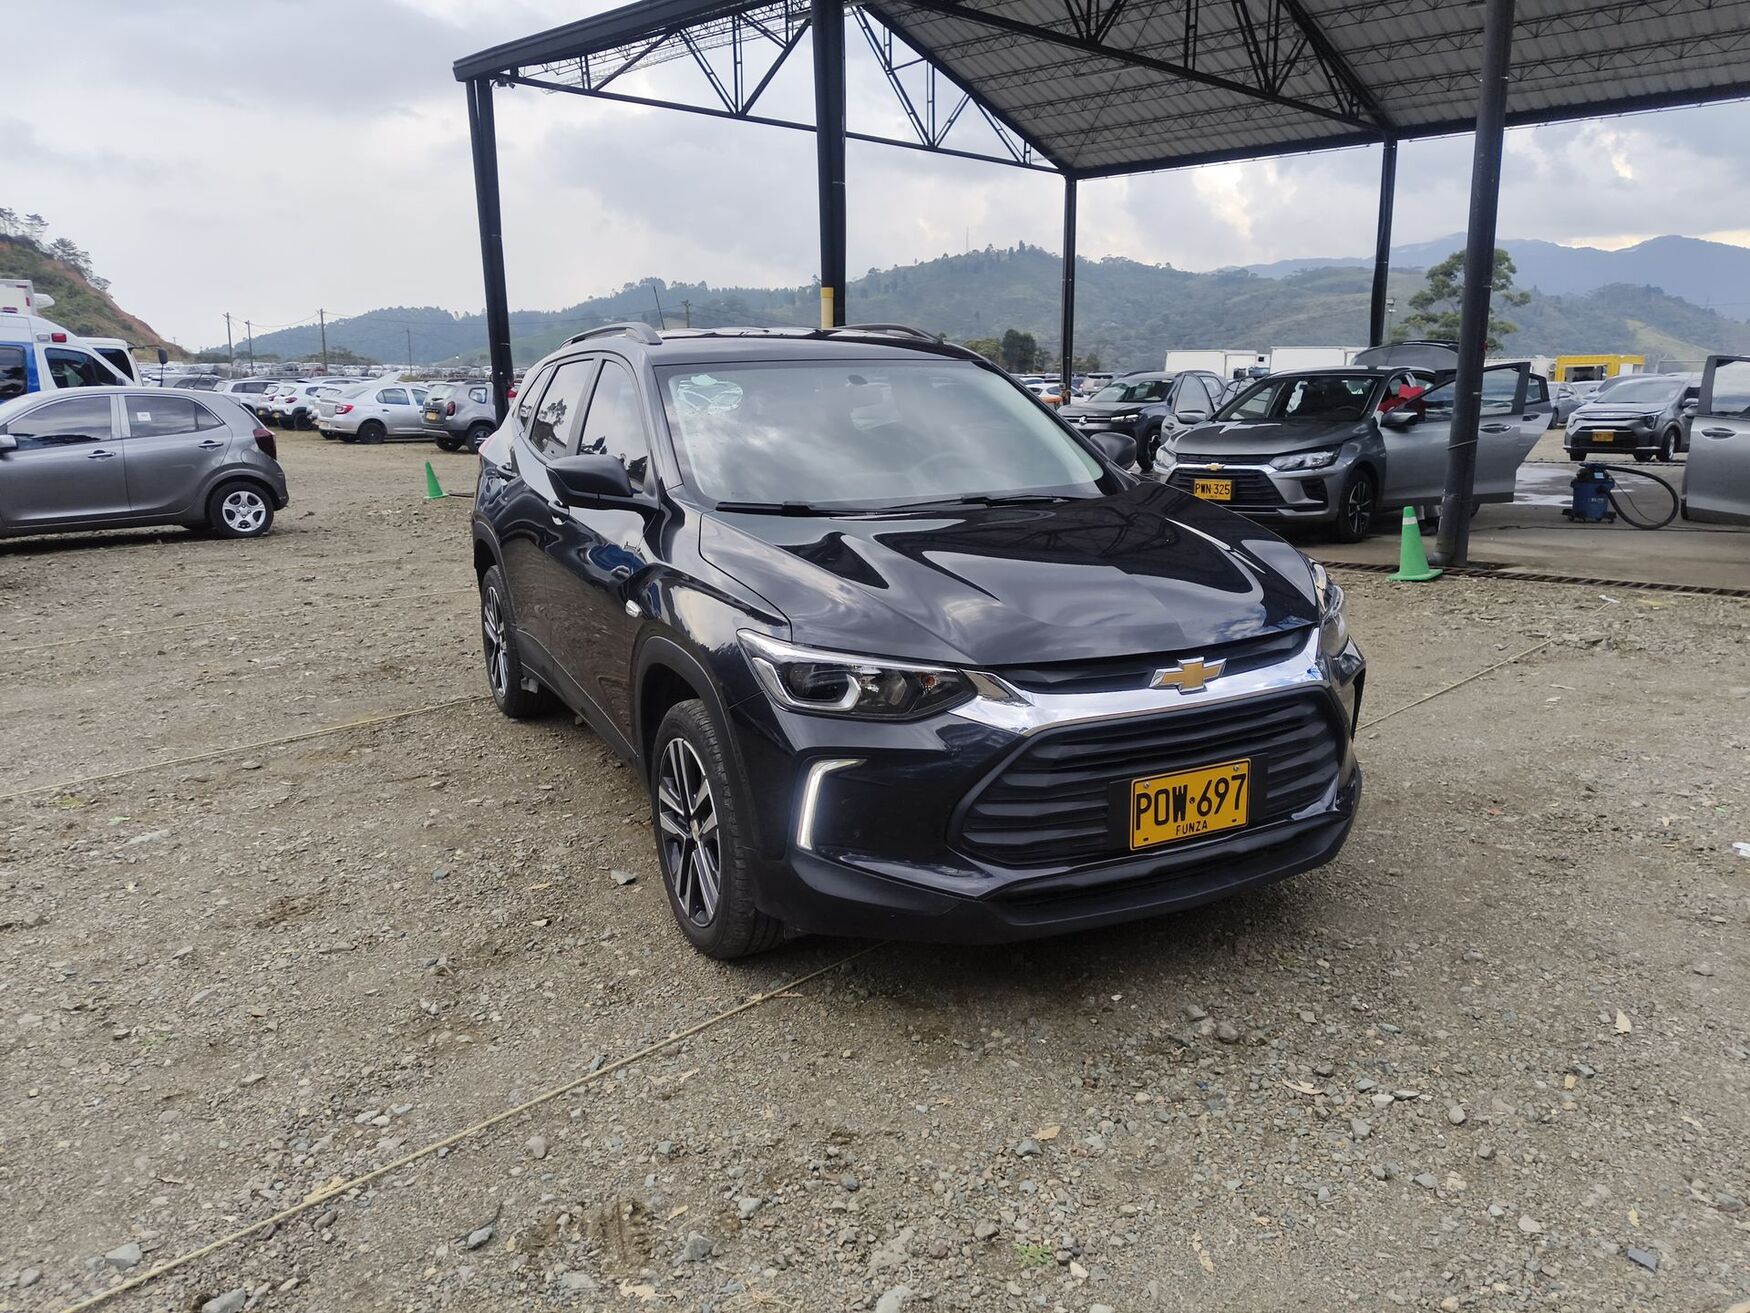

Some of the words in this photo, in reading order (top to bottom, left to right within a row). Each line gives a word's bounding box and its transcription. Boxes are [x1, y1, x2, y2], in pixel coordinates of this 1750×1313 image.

[1195, 483, 1211, 495] PWN
[1213, 483, 1231, 495] 325
[1175, 820, 1208, 836] FUNZA
